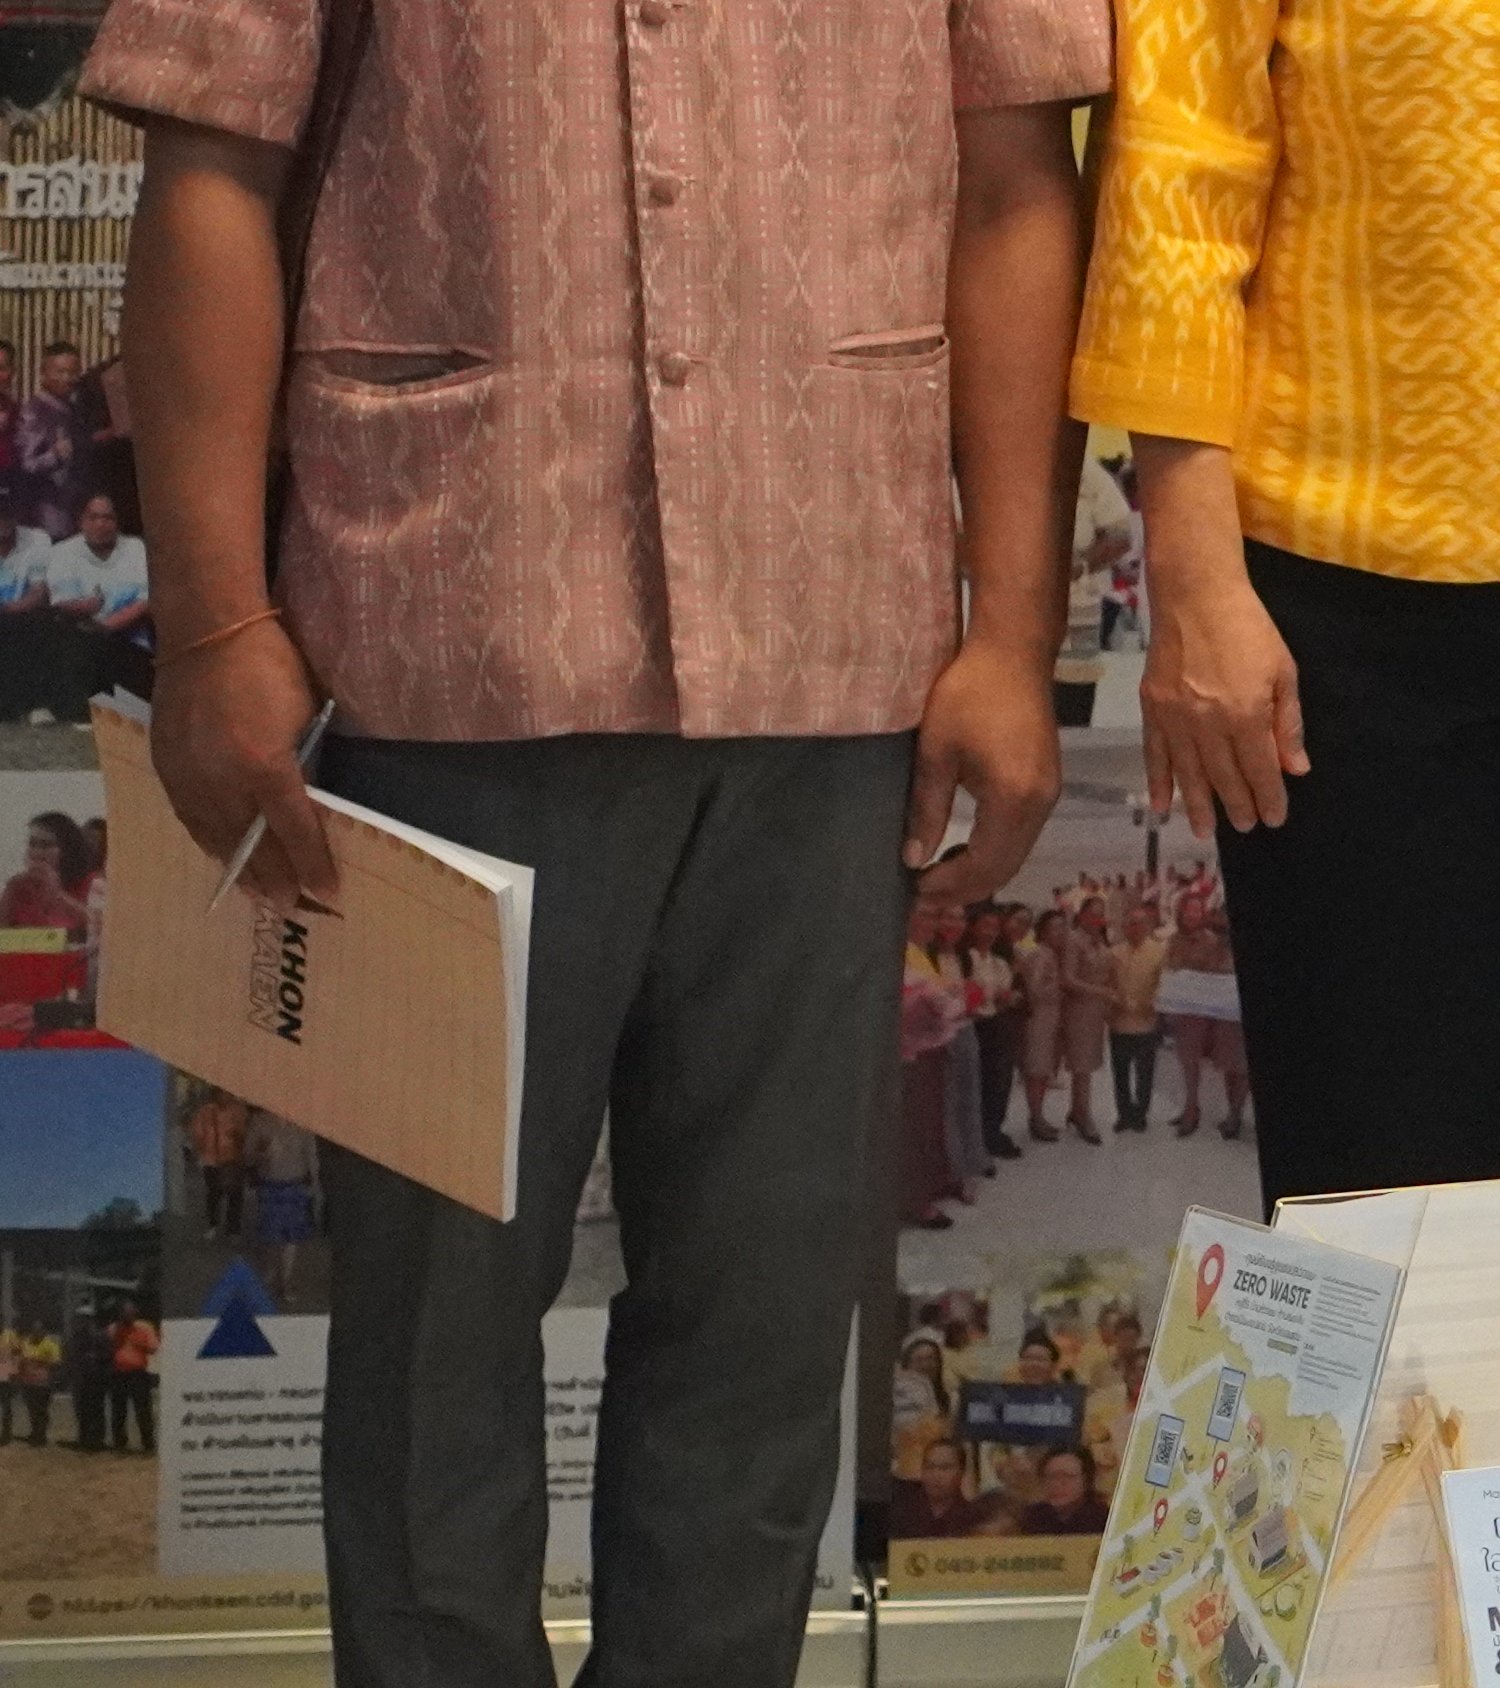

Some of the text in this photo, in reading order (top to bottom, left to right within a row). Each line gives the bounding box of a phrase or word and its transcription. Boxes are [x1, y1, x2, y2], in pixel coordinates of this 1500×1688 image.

[276, 917, 308, 1045] KHON
[1233, 1269, 1312, 1310] ZERO WASTE
